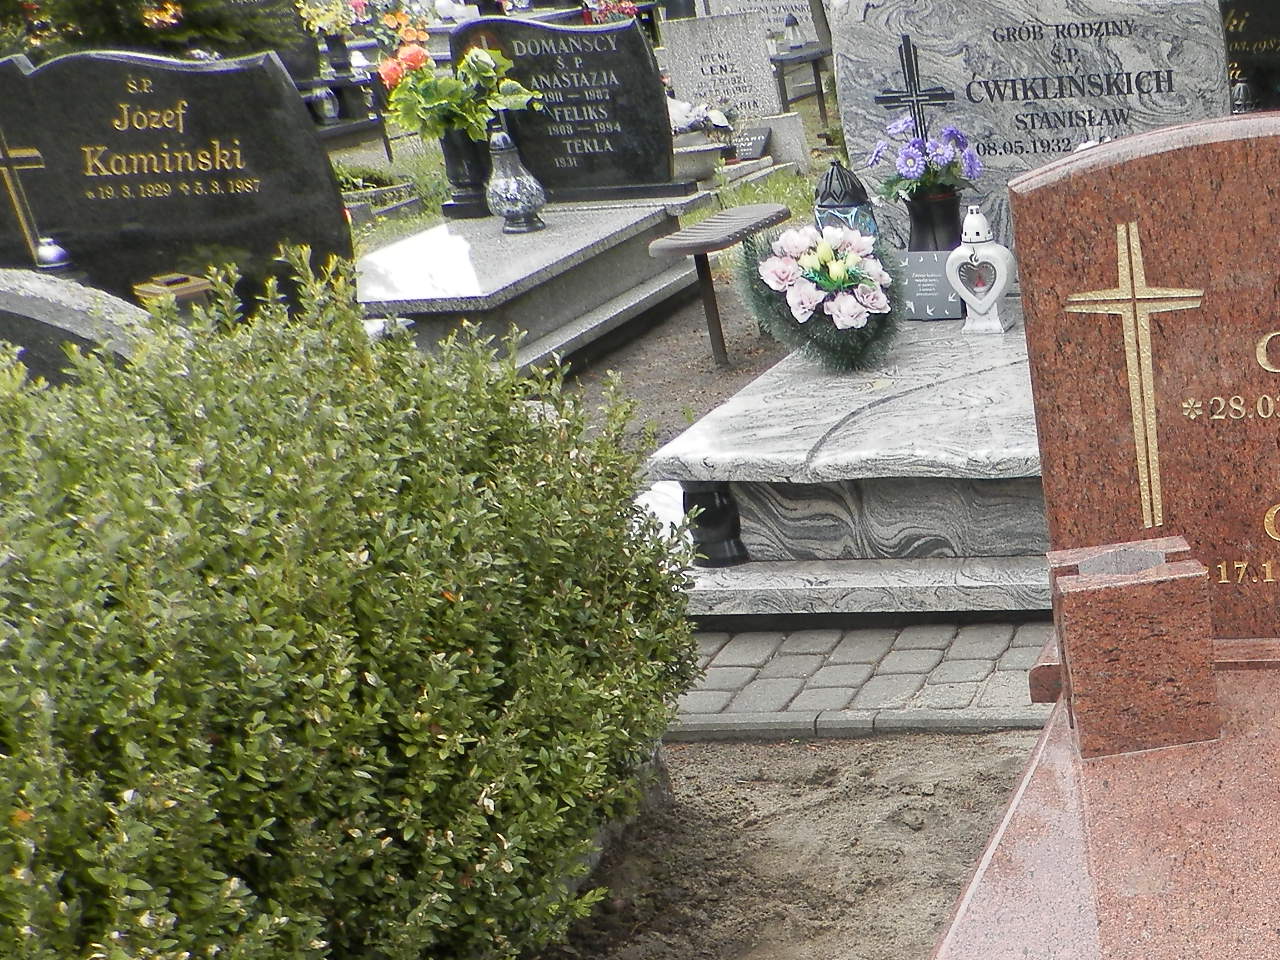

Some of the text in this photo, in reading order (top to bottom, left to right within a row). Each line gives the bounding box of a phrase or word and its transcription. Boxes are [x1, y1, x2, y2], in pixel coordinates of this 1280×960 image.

[992, 19, 1136, 43] GRÓB RODZINY
[530, 69, 621, 90] ANASTAZJA
[965, 67, 1176, 105] ĆWIKLIŃSKICH
[553, 105, 608, 123] FELIKS
[1014, 107, 1132, 131] STANISŁAW
[562, 140, 615, 155] TEKLA
[975, 137, 1073, 157] 08.05.1932
